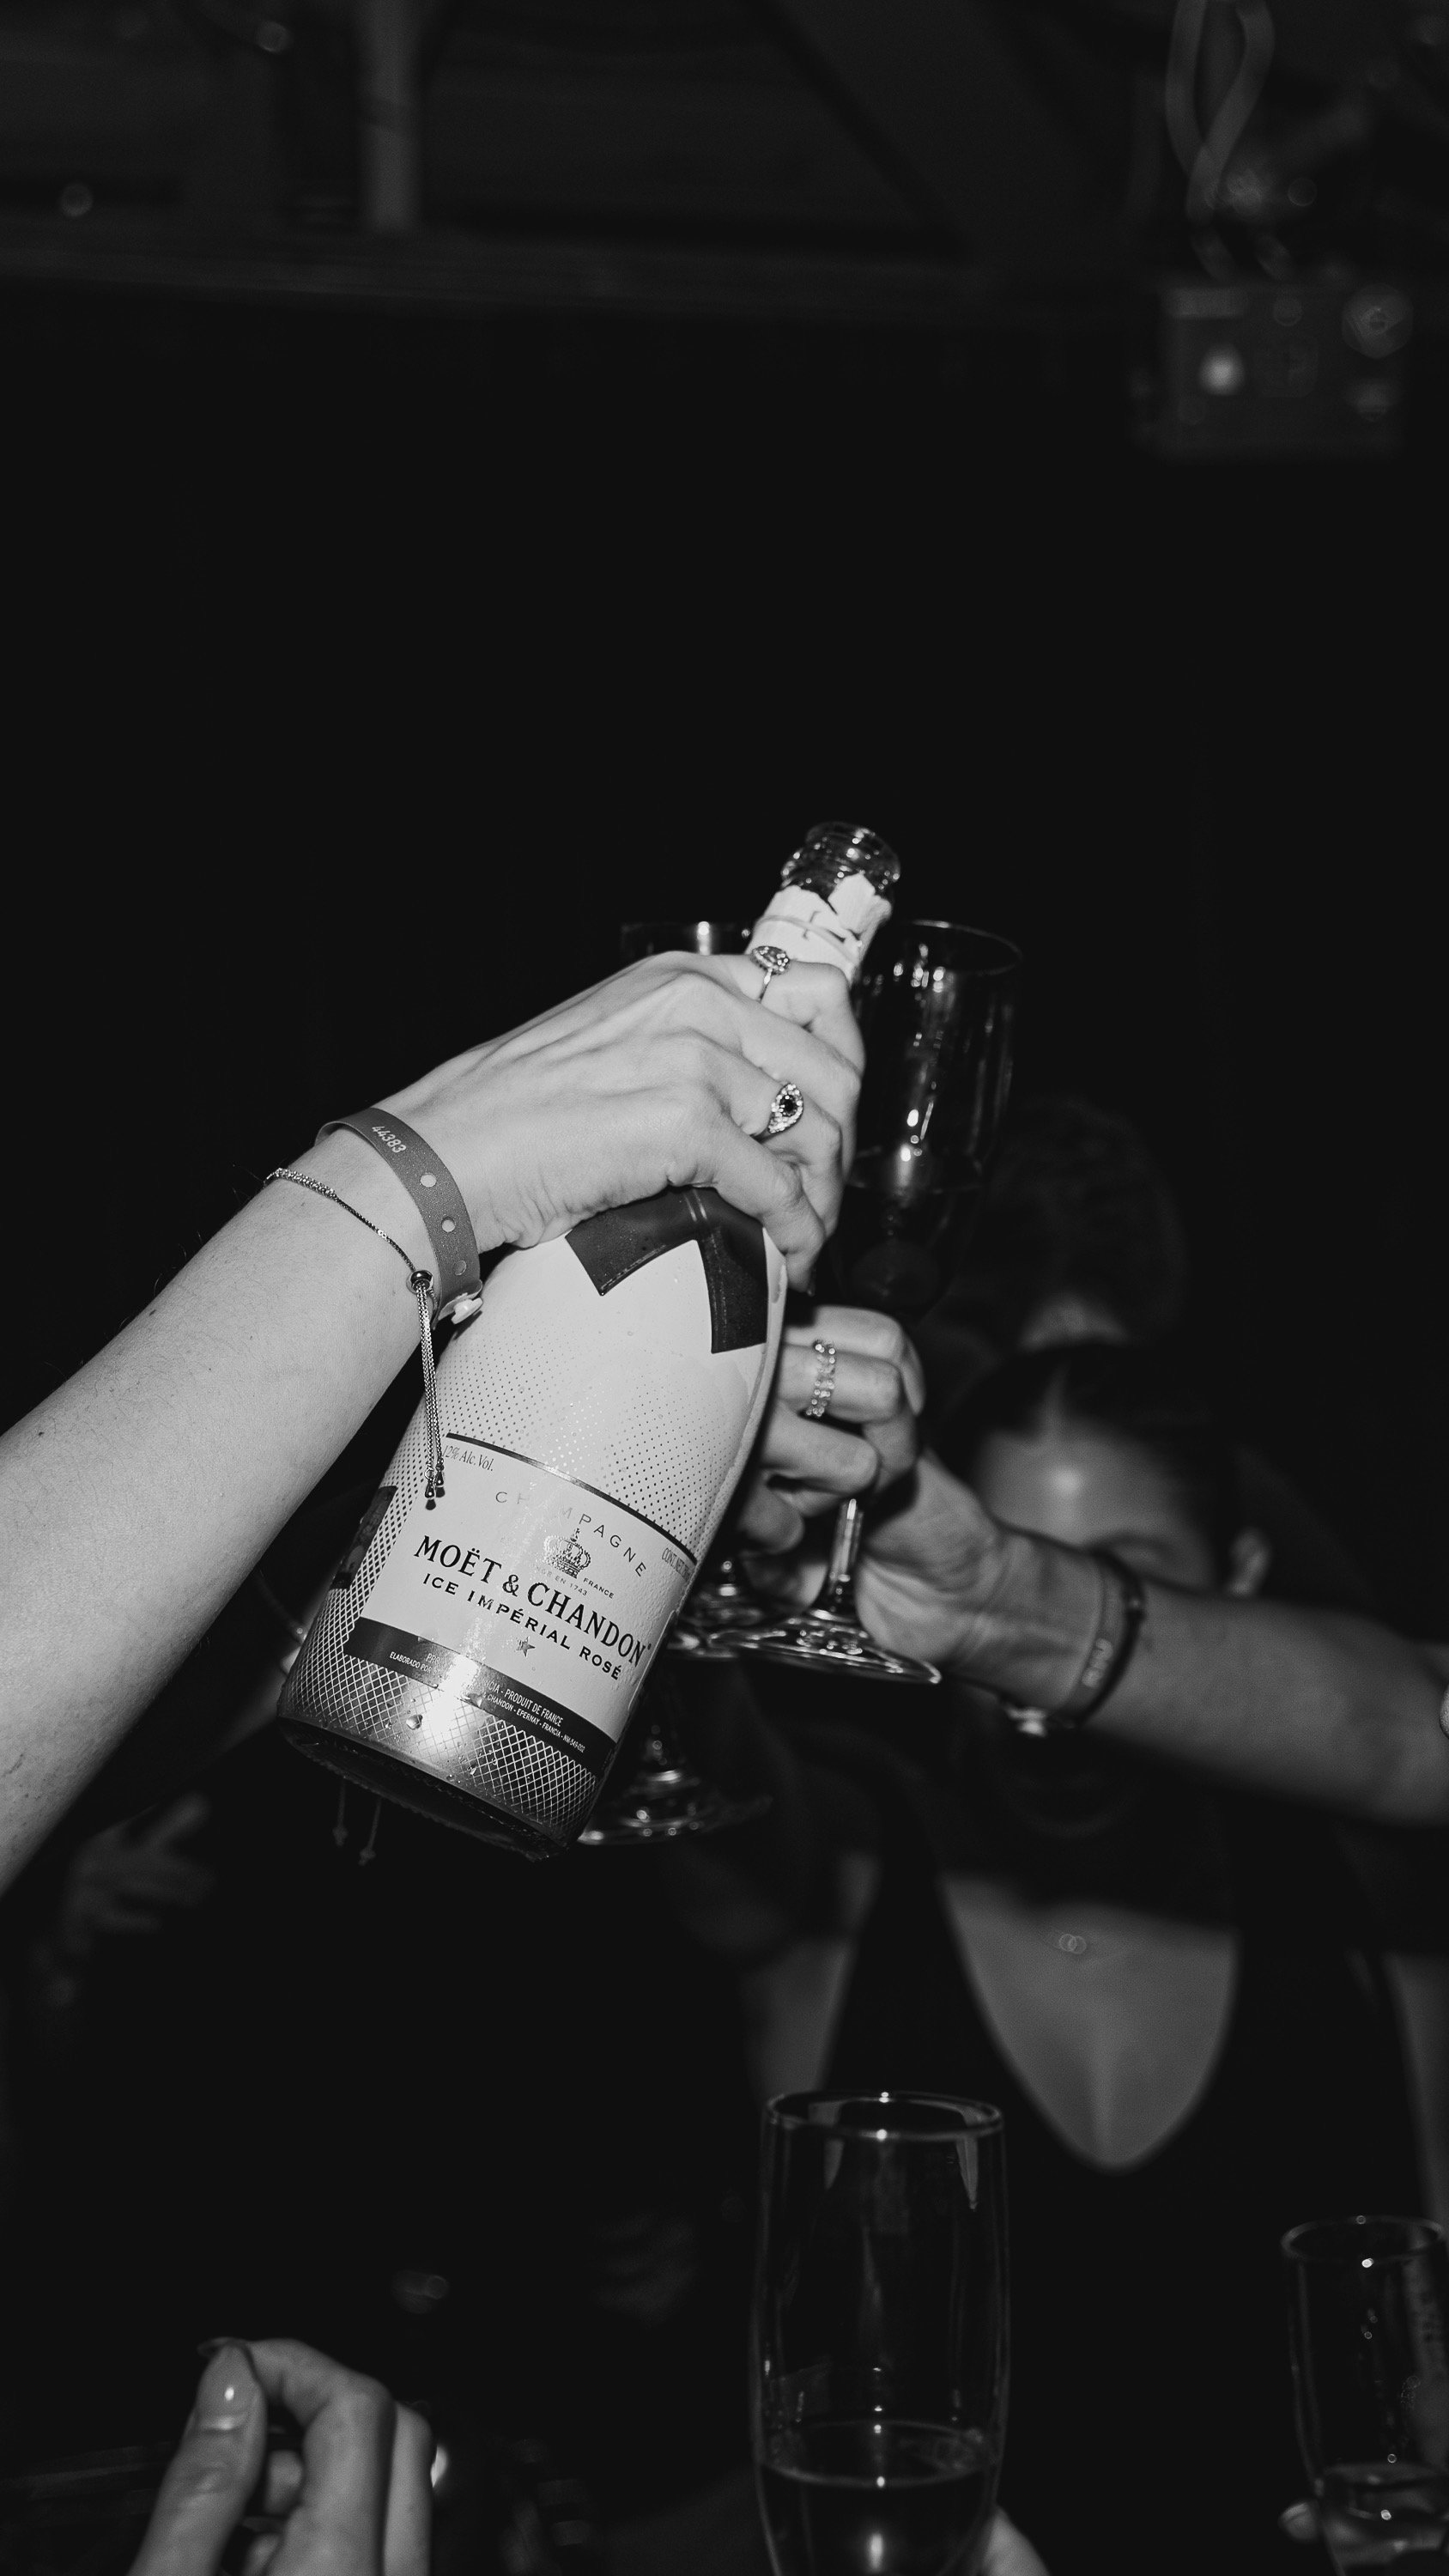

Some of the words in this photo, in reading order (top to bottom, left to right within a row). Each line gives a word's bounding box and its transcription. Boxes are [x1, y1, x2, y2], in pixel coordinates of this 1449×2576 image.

[372, 1126, 407, 1153] 44383
[495, 1492, 647, 1577] CHMPAGNE
[413, 1535, 502, 1583] MOËT
[501, 1574, 519, 1597] &
[569, 1583, 588, 1595] 1743
[583, 1577, 615, 1599] FRANCE
[422, 1573, 459, 1595] ICE
[467, 1591, 571, 1649] IMPÉRIAL
[579, 1646, 622, 1680] ROSÉ
[389, 1651, 421, 1669] ELABORADO
[487, 1694, 515, 1712] CHANDON
[516, 1708, 541, 1726] EPERNAY
[542, 1722, 561, 1738] FRANCIA
[504, 1688, 534, 1710] PRODUIT
[531, 1703, 543, 1716] DE
[540, 1708, 564, 1728] FRANCE
